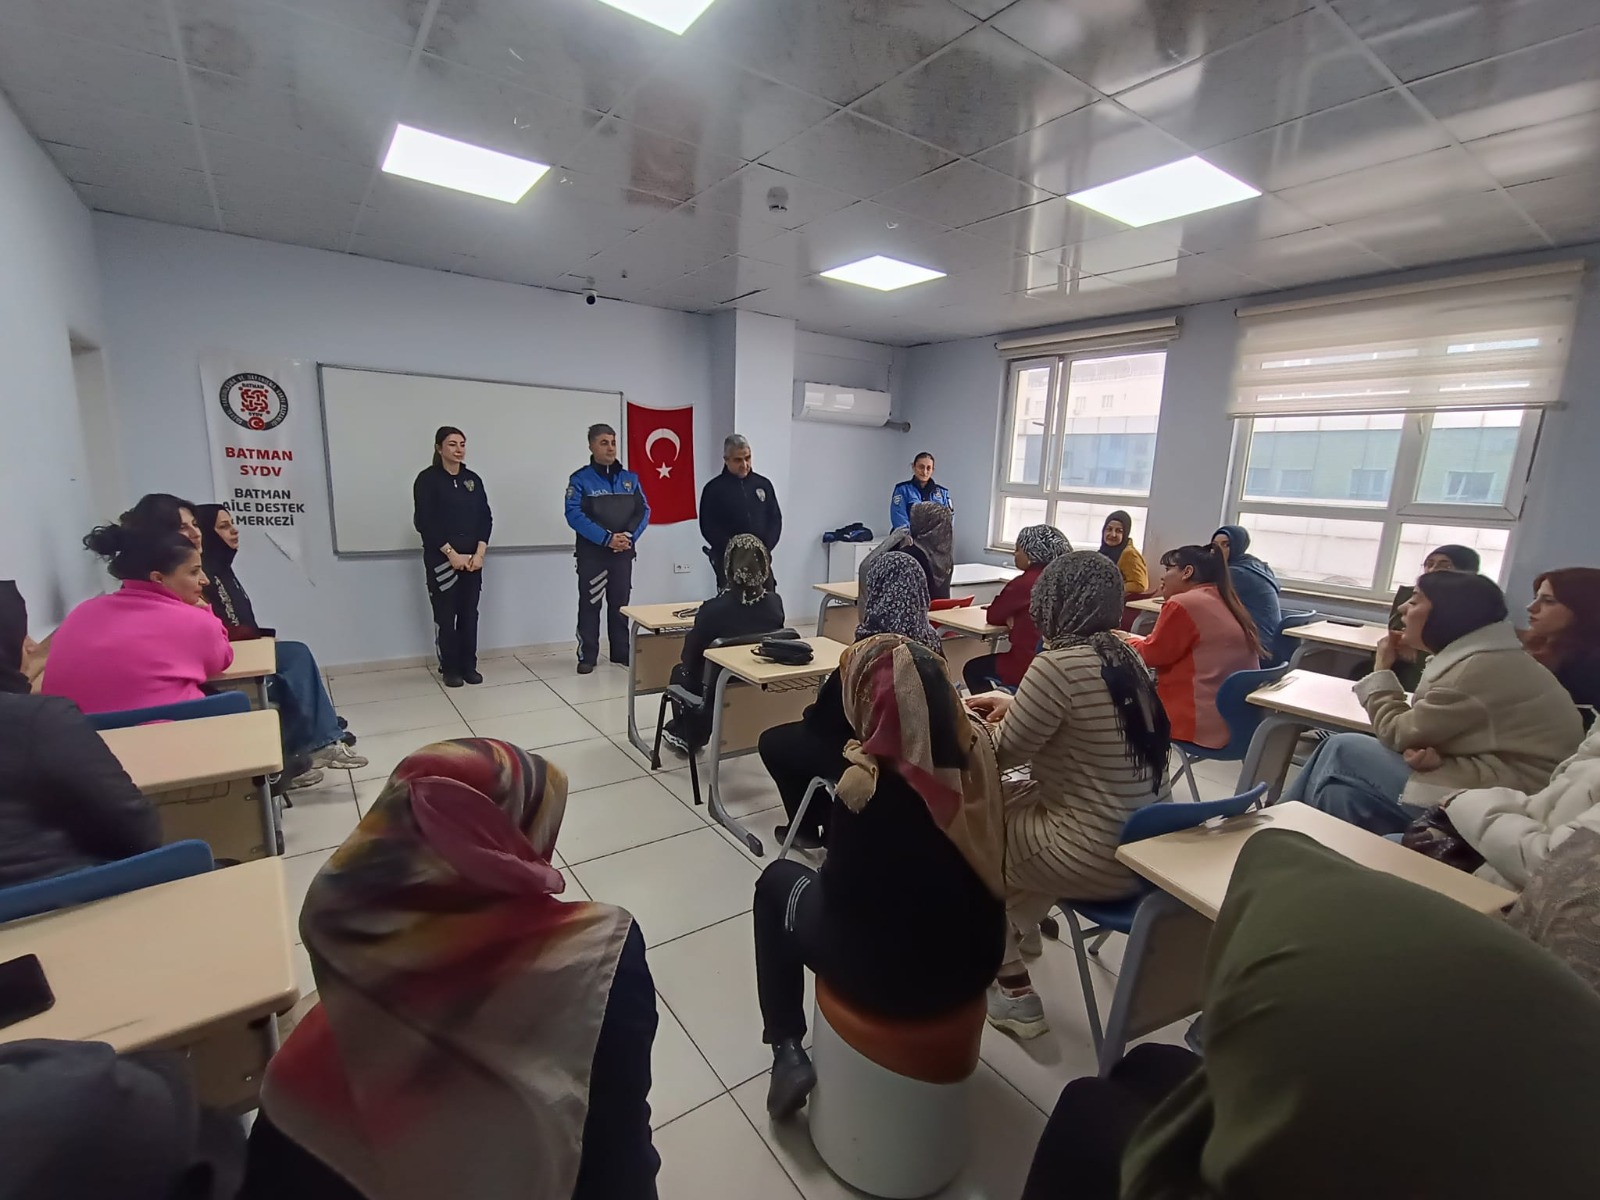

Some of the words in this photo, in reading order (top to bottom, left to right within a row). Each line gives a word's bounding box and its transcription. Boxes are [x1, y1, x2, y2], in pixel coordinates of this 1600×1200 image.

[225, 447, 293, 461] BATMAN
[240, 465, 282, 477] SYDV
[234, 488, 291, 499] BATMAN
[255, 502, 305, 513] DESTEK
[236, 514, 294, 526] MERKEZİ
